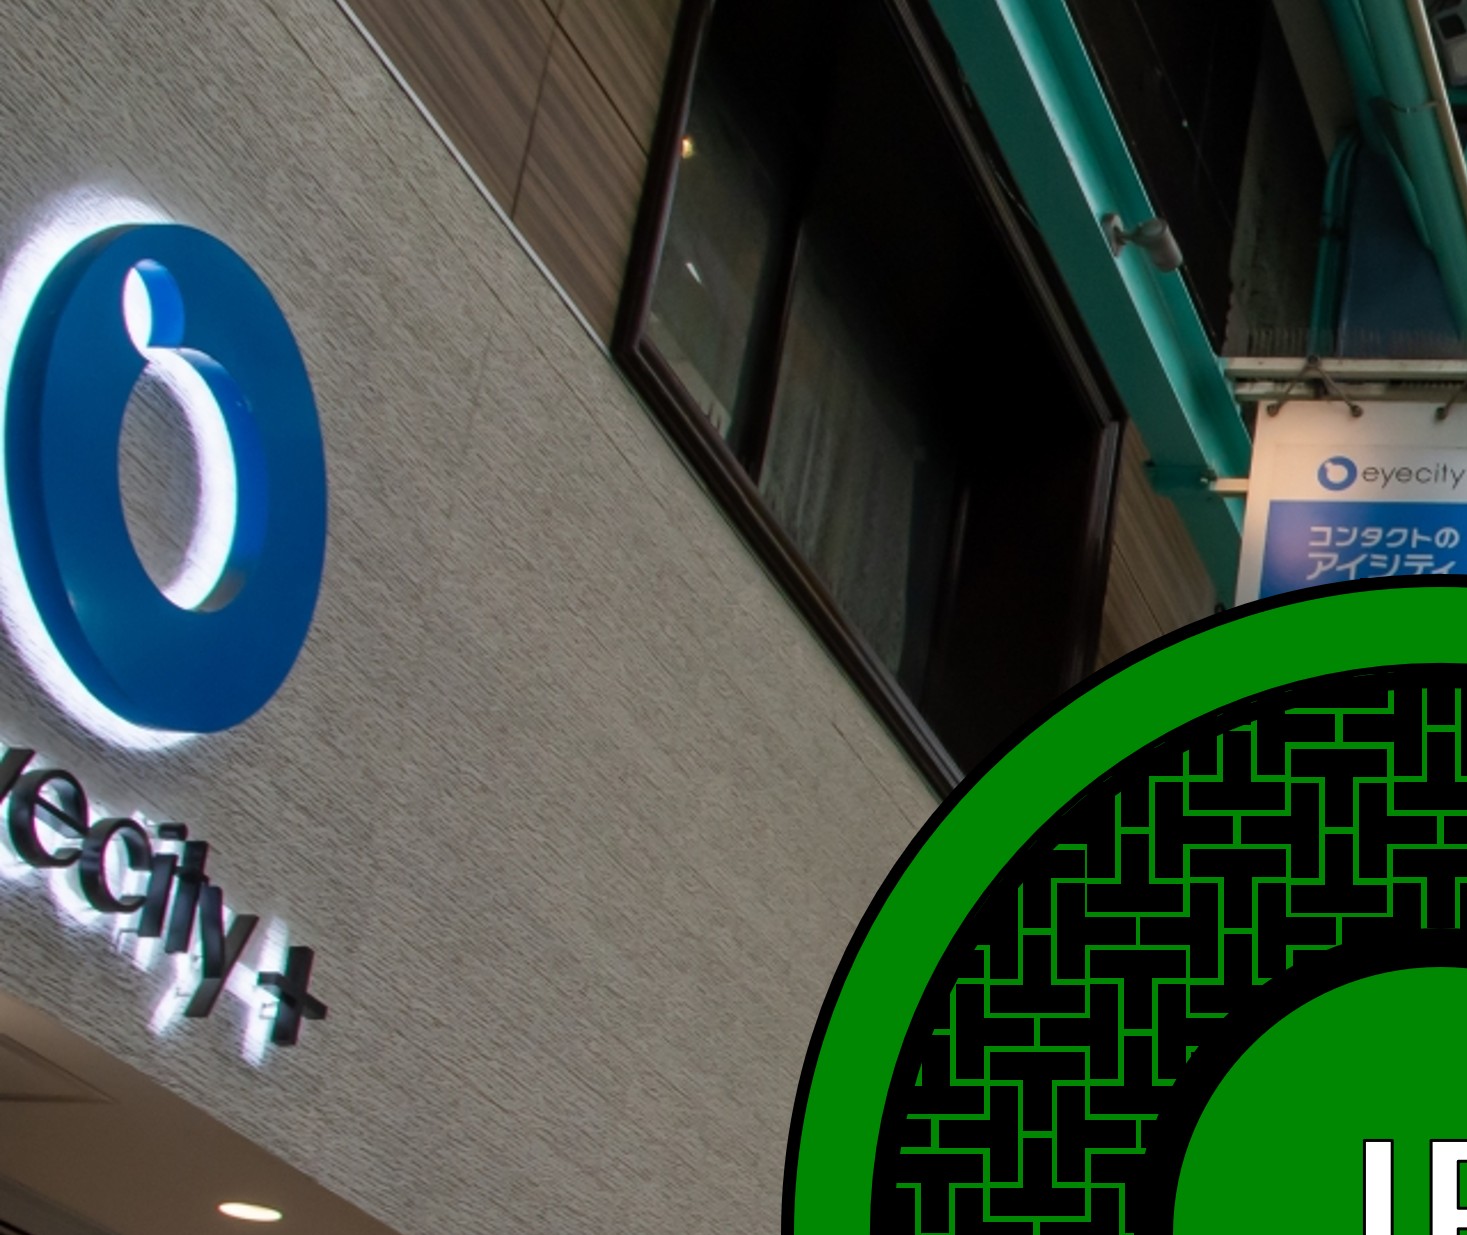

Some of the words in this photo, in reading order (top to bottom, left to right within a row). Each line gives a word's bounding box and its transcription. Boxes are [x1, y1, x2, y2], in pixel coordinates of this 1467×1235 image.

[1362, 463, 1466, 491] eyecity
[1306, 526, 1460, 549] コンタクトの
